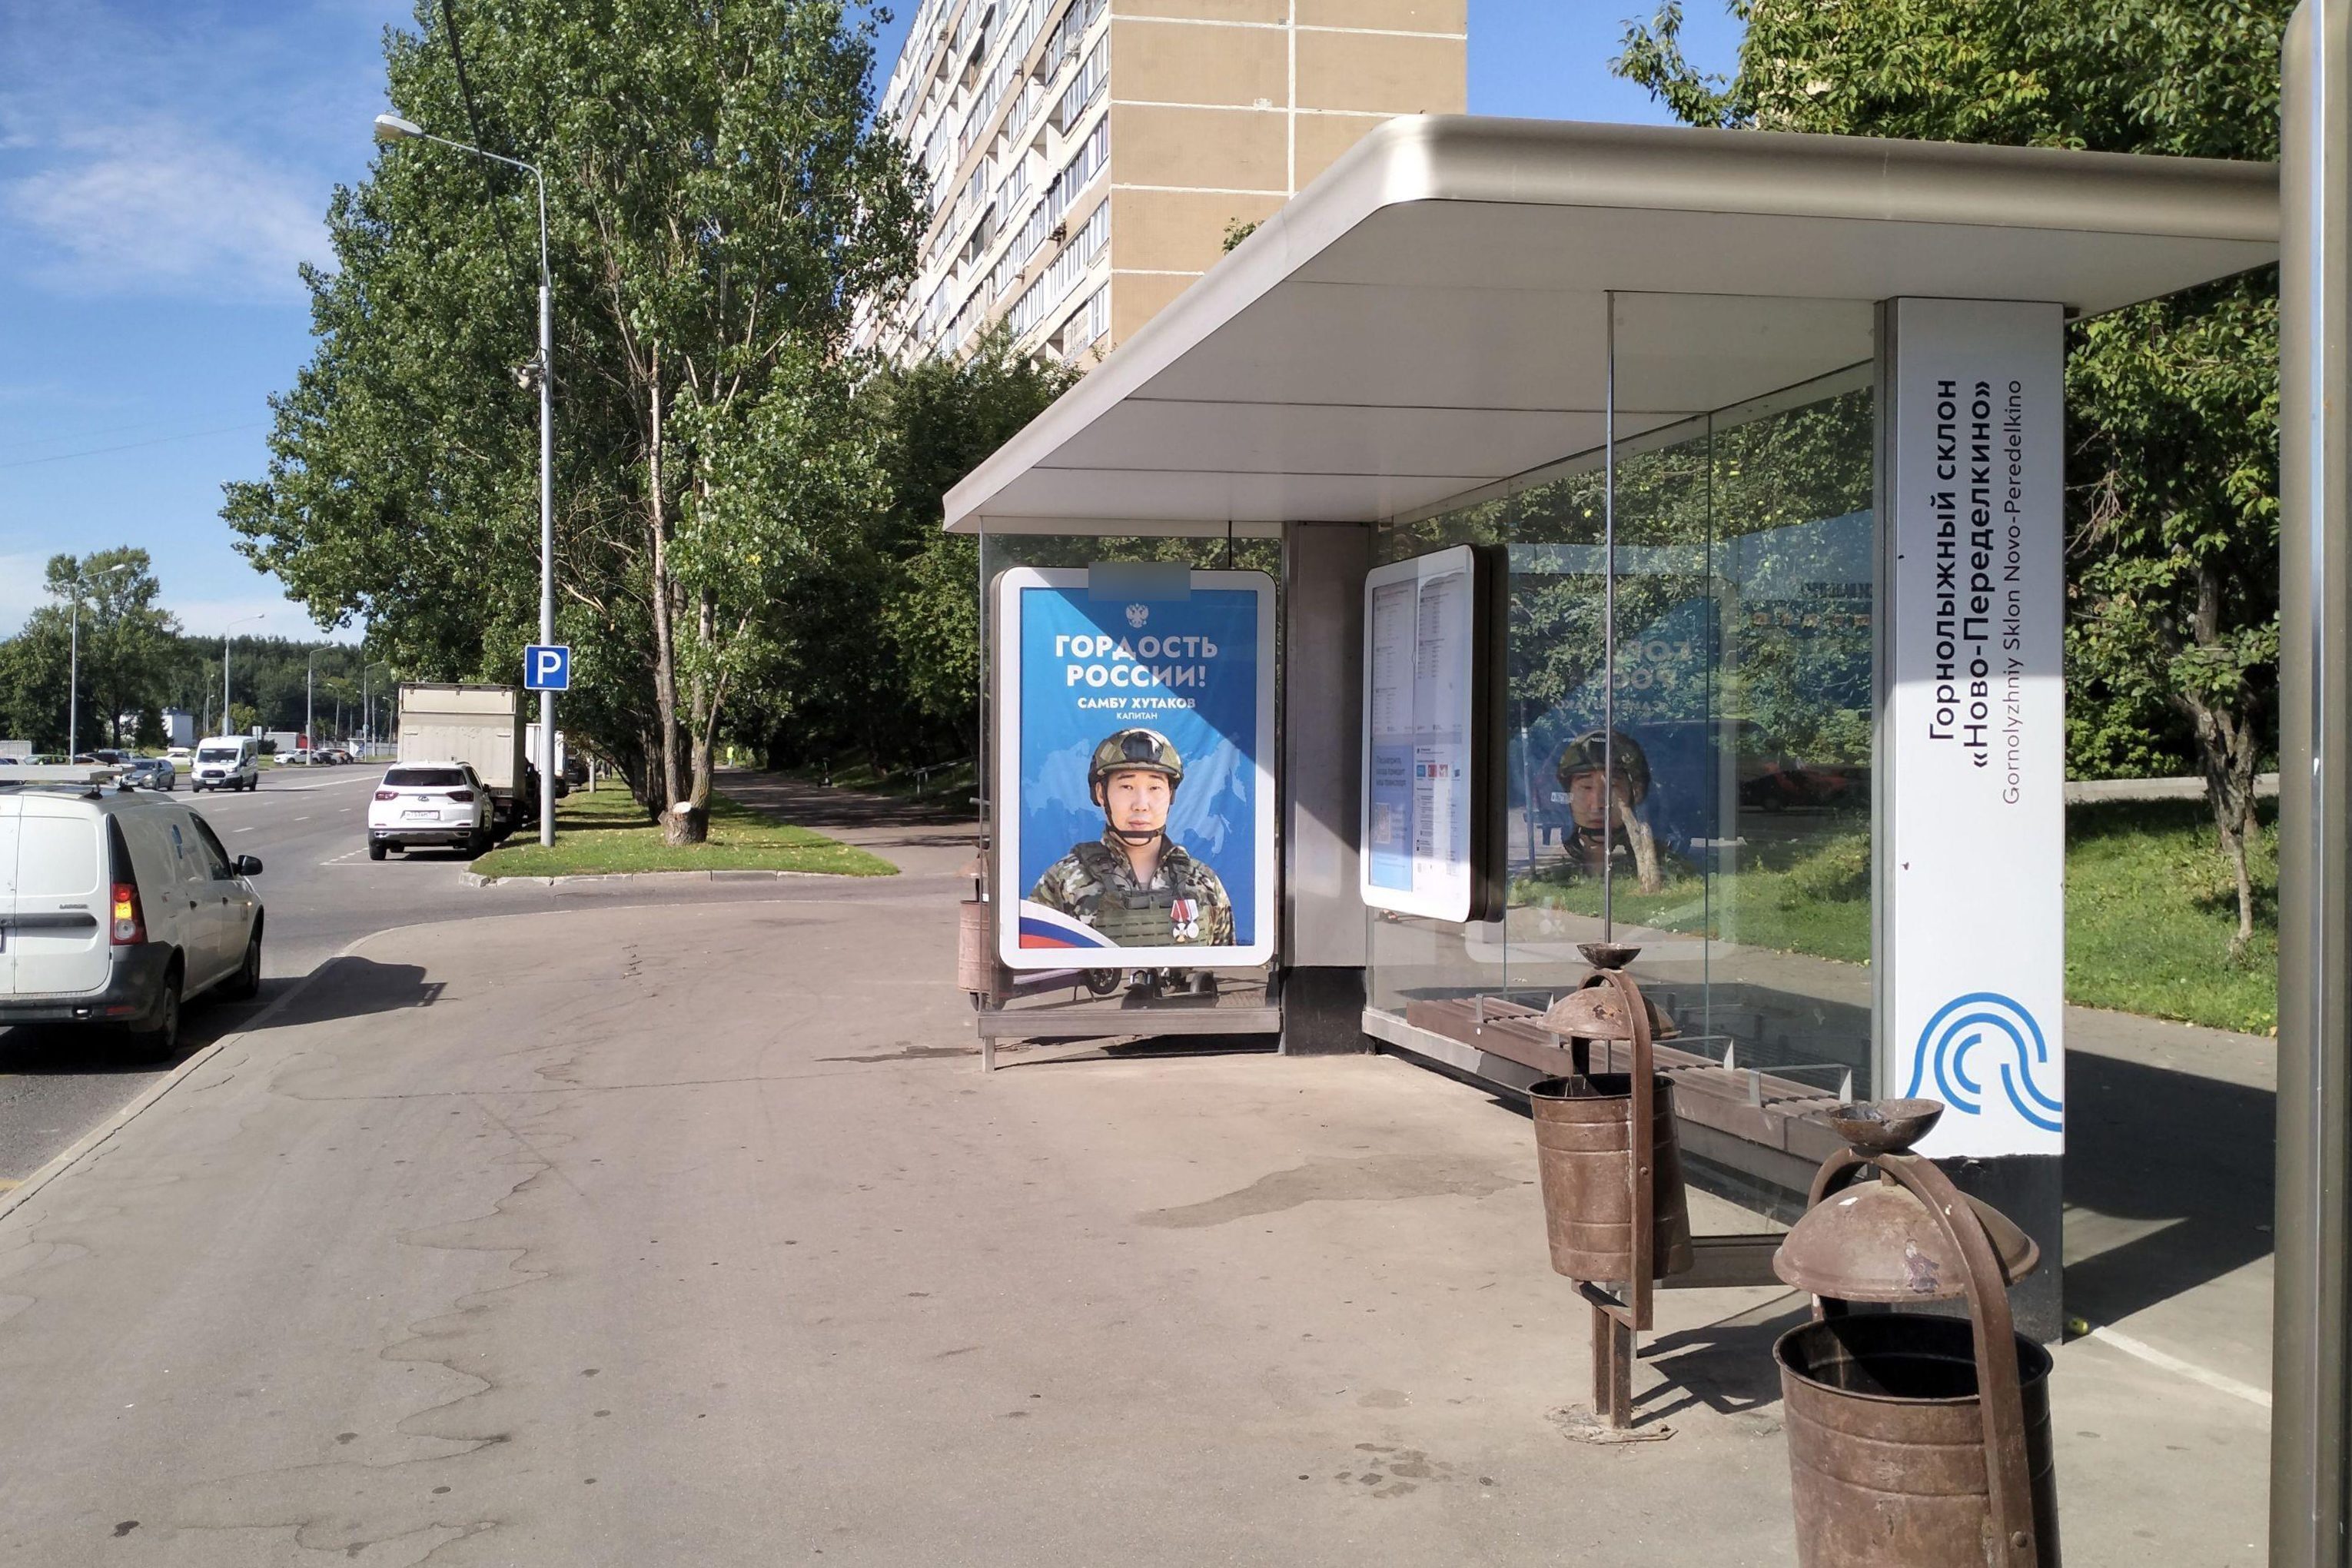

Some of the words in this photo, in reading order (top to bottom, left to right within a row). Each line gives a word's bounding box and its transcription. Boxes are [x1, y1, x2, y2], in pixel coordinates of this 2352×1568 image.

[1936, 380, 1957, 480] склон
[2003, 380, 2021, 581] Novo-Peredelkino
[1963, 380, 1995, 768] «Ново-Переделкино»
[1929, 492, 1960, 739] Горнолыжный
[2002, 590, 2021, 650] Sklon
[537, 650, 561, 684] P
[1055, 635, 1218, 661] ГОРДОСТЬ
[1066, 664, 1206, 687] РОССИИ!
[1078, 697, 1127, 709] САМБУ
[1131, 697, 1196, 709] ХУТАКОВ
[1116, 712, 1158, 720] КАПИТАН
[2002, 657, 2024, 804] Gornolyzhniy
